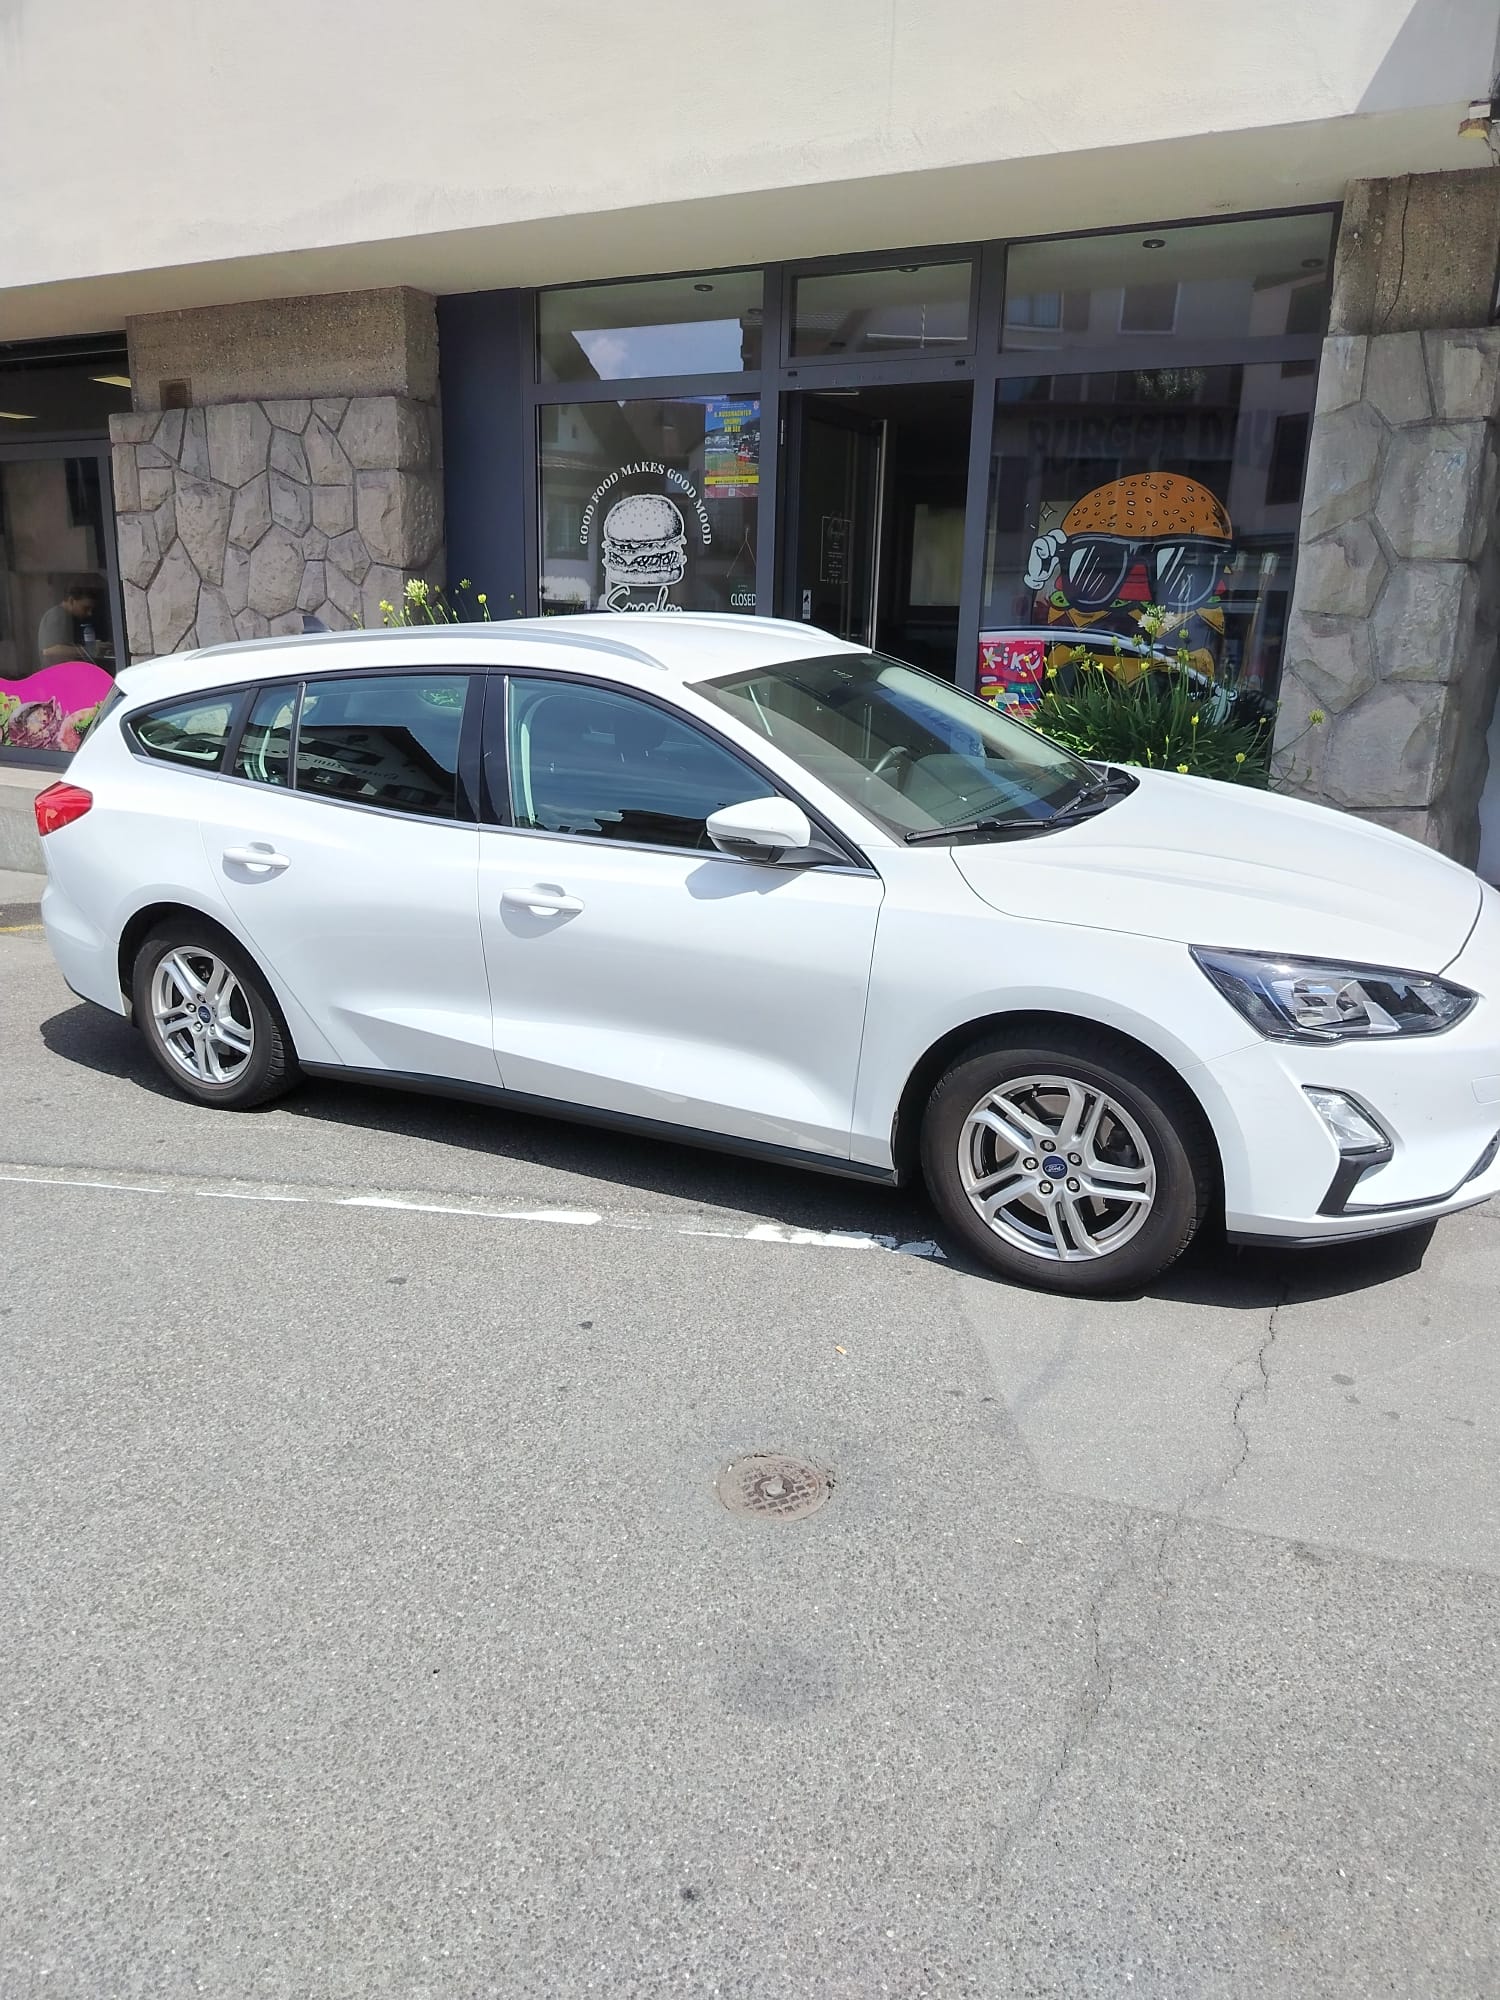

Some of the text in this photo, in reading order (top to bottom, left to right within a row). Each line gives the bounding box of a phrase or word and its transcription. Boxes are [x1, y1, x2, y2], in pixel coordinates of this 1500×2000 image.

[579, 461, 713, 545] GOOD FOOD MAKES GOOD MOOD
[730, 593, 757, 606] CLOSED
